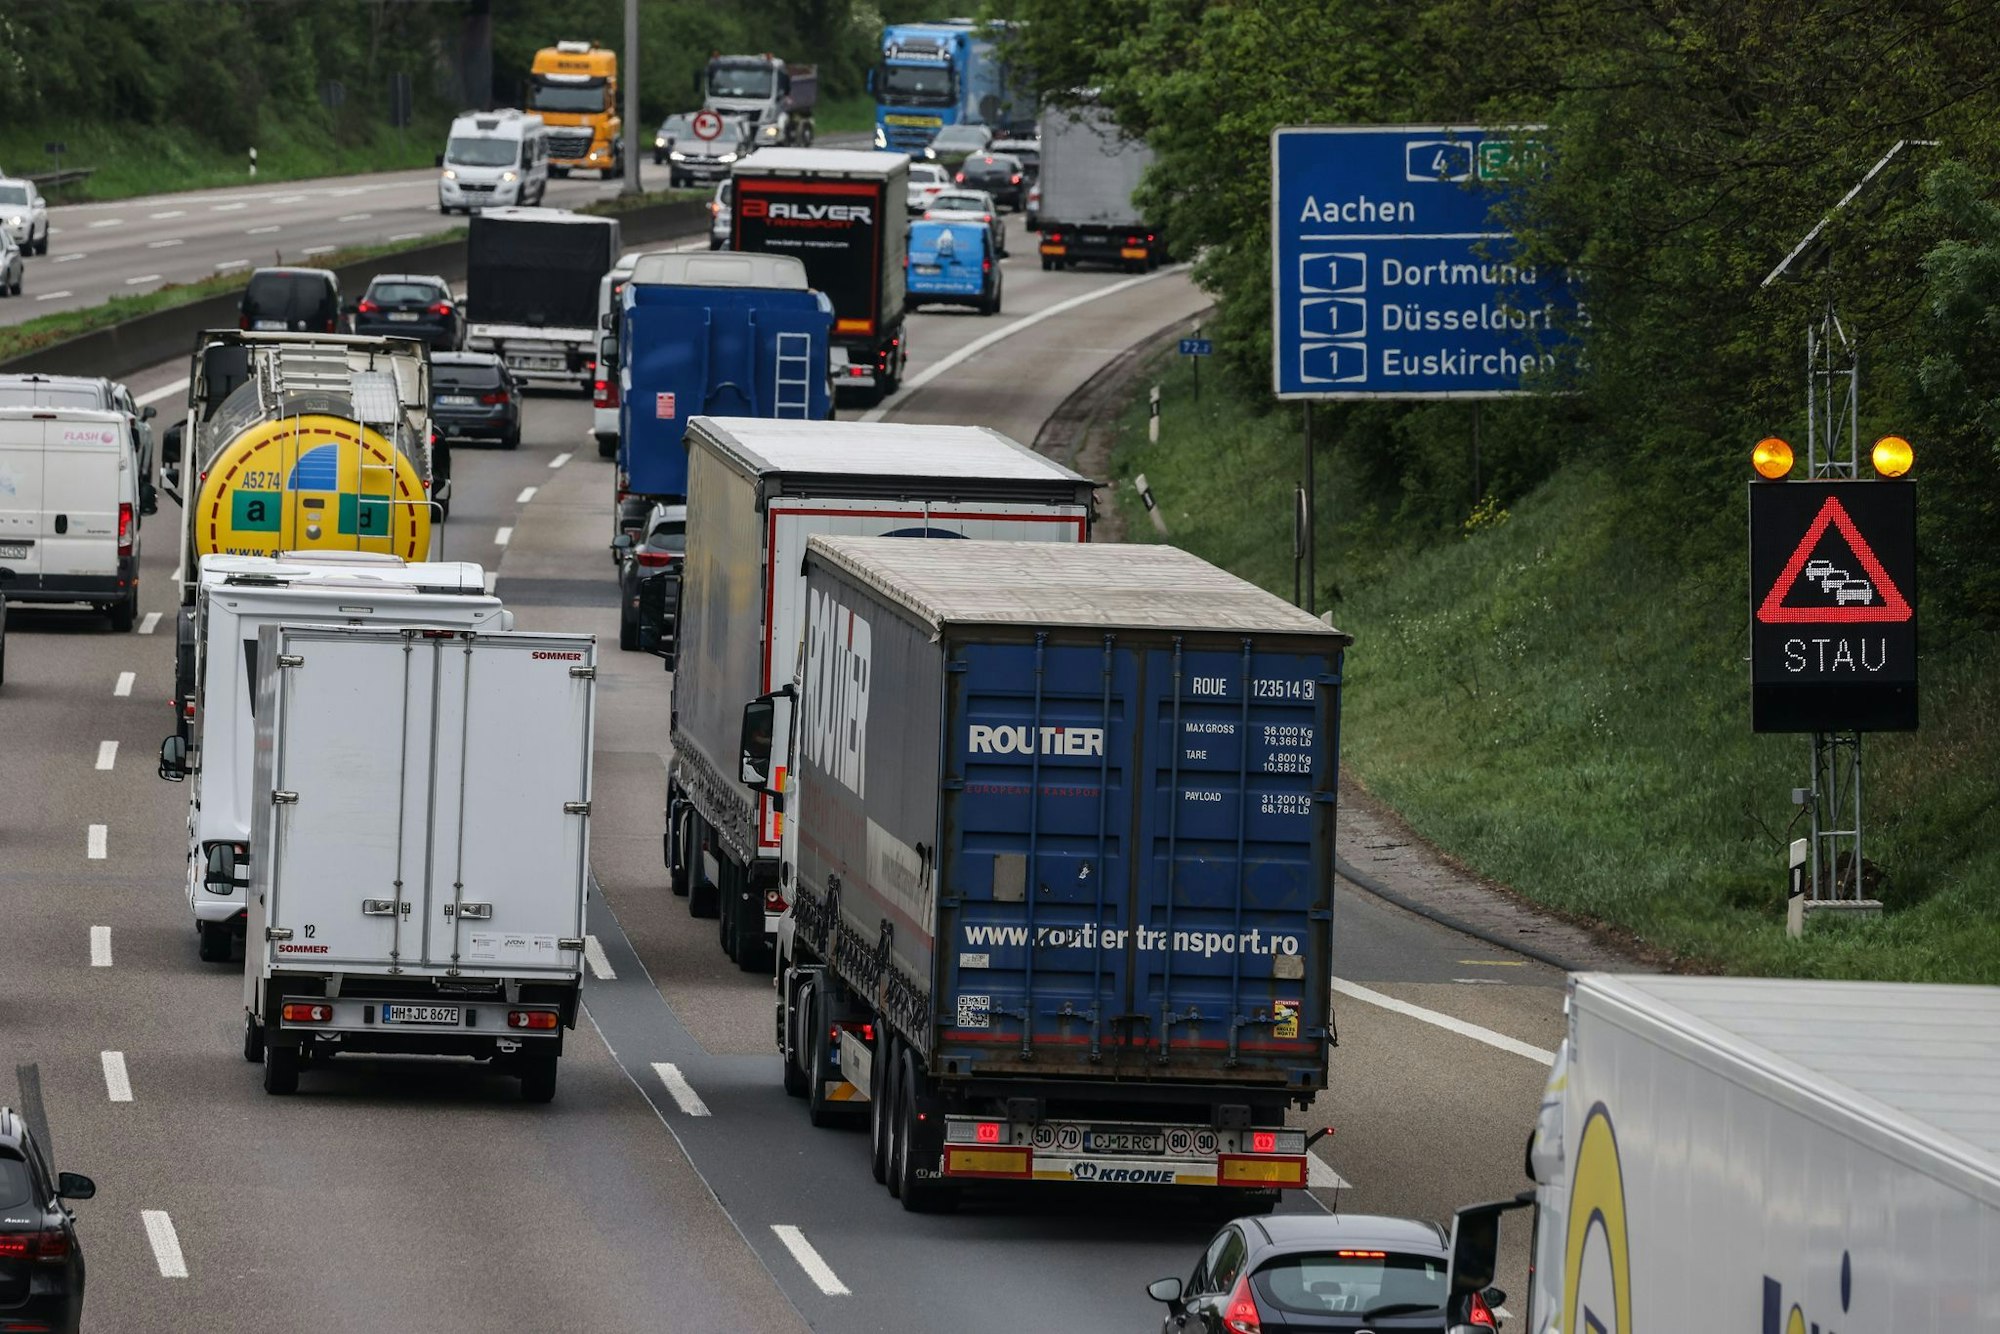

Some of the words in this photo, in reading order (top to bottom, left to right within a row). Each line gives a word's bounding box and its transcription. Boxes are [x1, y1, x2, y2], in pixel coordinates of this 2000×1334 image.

[1432, 150, 1447, 173] 4
[742, 200, 873, 225] BALVER
[1300, 195, 1415, 223] Aachen
[1329, 261, 1337, 285] 1
[1383, 259, 1536, 285] Dortmund
[1329, 306, 1338, 330] 1
[1383, 303, 1554, 331] Düsseldorf
[1329, 351, 1338, 375] 1
[1383, 347, 1555, 376] Euskirchen
[64, 432, 99, 441] FLASH
[246, 499, 265, 522] a
[226, 548, 286, 559] www.a
[532, 651, 581, 661] SOMMER
[1785, 638, 1886, 672] STAU
[1193, 677, 1227, 696] ROUE
[1253, 679, 1300, 698] 123514
[1185, 723, 1204, 733] MAX
[1205, 724, 1235, 735] GROSS
[1263, 726, 1298, 737] 36.000
[1300, 727, 1313, 739] Kg
[1263, 736, 1298, 747] 79,366
[1300, 736, 1312, 747] Lb
[1185, 750, 1207, 760] TARE
[1268, 753, 1297, 763] 4.800
[1299, 753, 1312, 765] Kg
[1263, 763, 1296, 773] 10,582
[1298, 763, 1310, 773] Lb
[966, 784, 1030, 795] EUROPEAN
[1039, 787, 1100, 797] RANSPOR
[1185, 791, 1222, 802] PAYLOAD
[1262, 794, 1296, 805] 31.200
[1298, 795, 1311, 806] Kg
[1261, 804, 1296, 815] 68,784
[1298, 804, 1310, 815] Lb
[304, 924, 316, 939] 12
[278, 944, 329, 954] SOMMER
[391, 1007, 406, 1019] HH
[414, 1007, 428, 1020] JC
[430, 1008, 458, 1021] 867E
[1036, 1129, 1051, 1143] 50
[1061, 1130, 1077, 1145] 70
[1094, 1135, 1111, 1149] CJ
[1116, 1135, 1129, 1149] 12
[1132, 1136, 1160, 1150] RCT
[1171, 1133, 1187, 1148] 80
[1198, 1135, 1213, 1150] 90
[1099, 1168, 1175, 1183] KRONE
